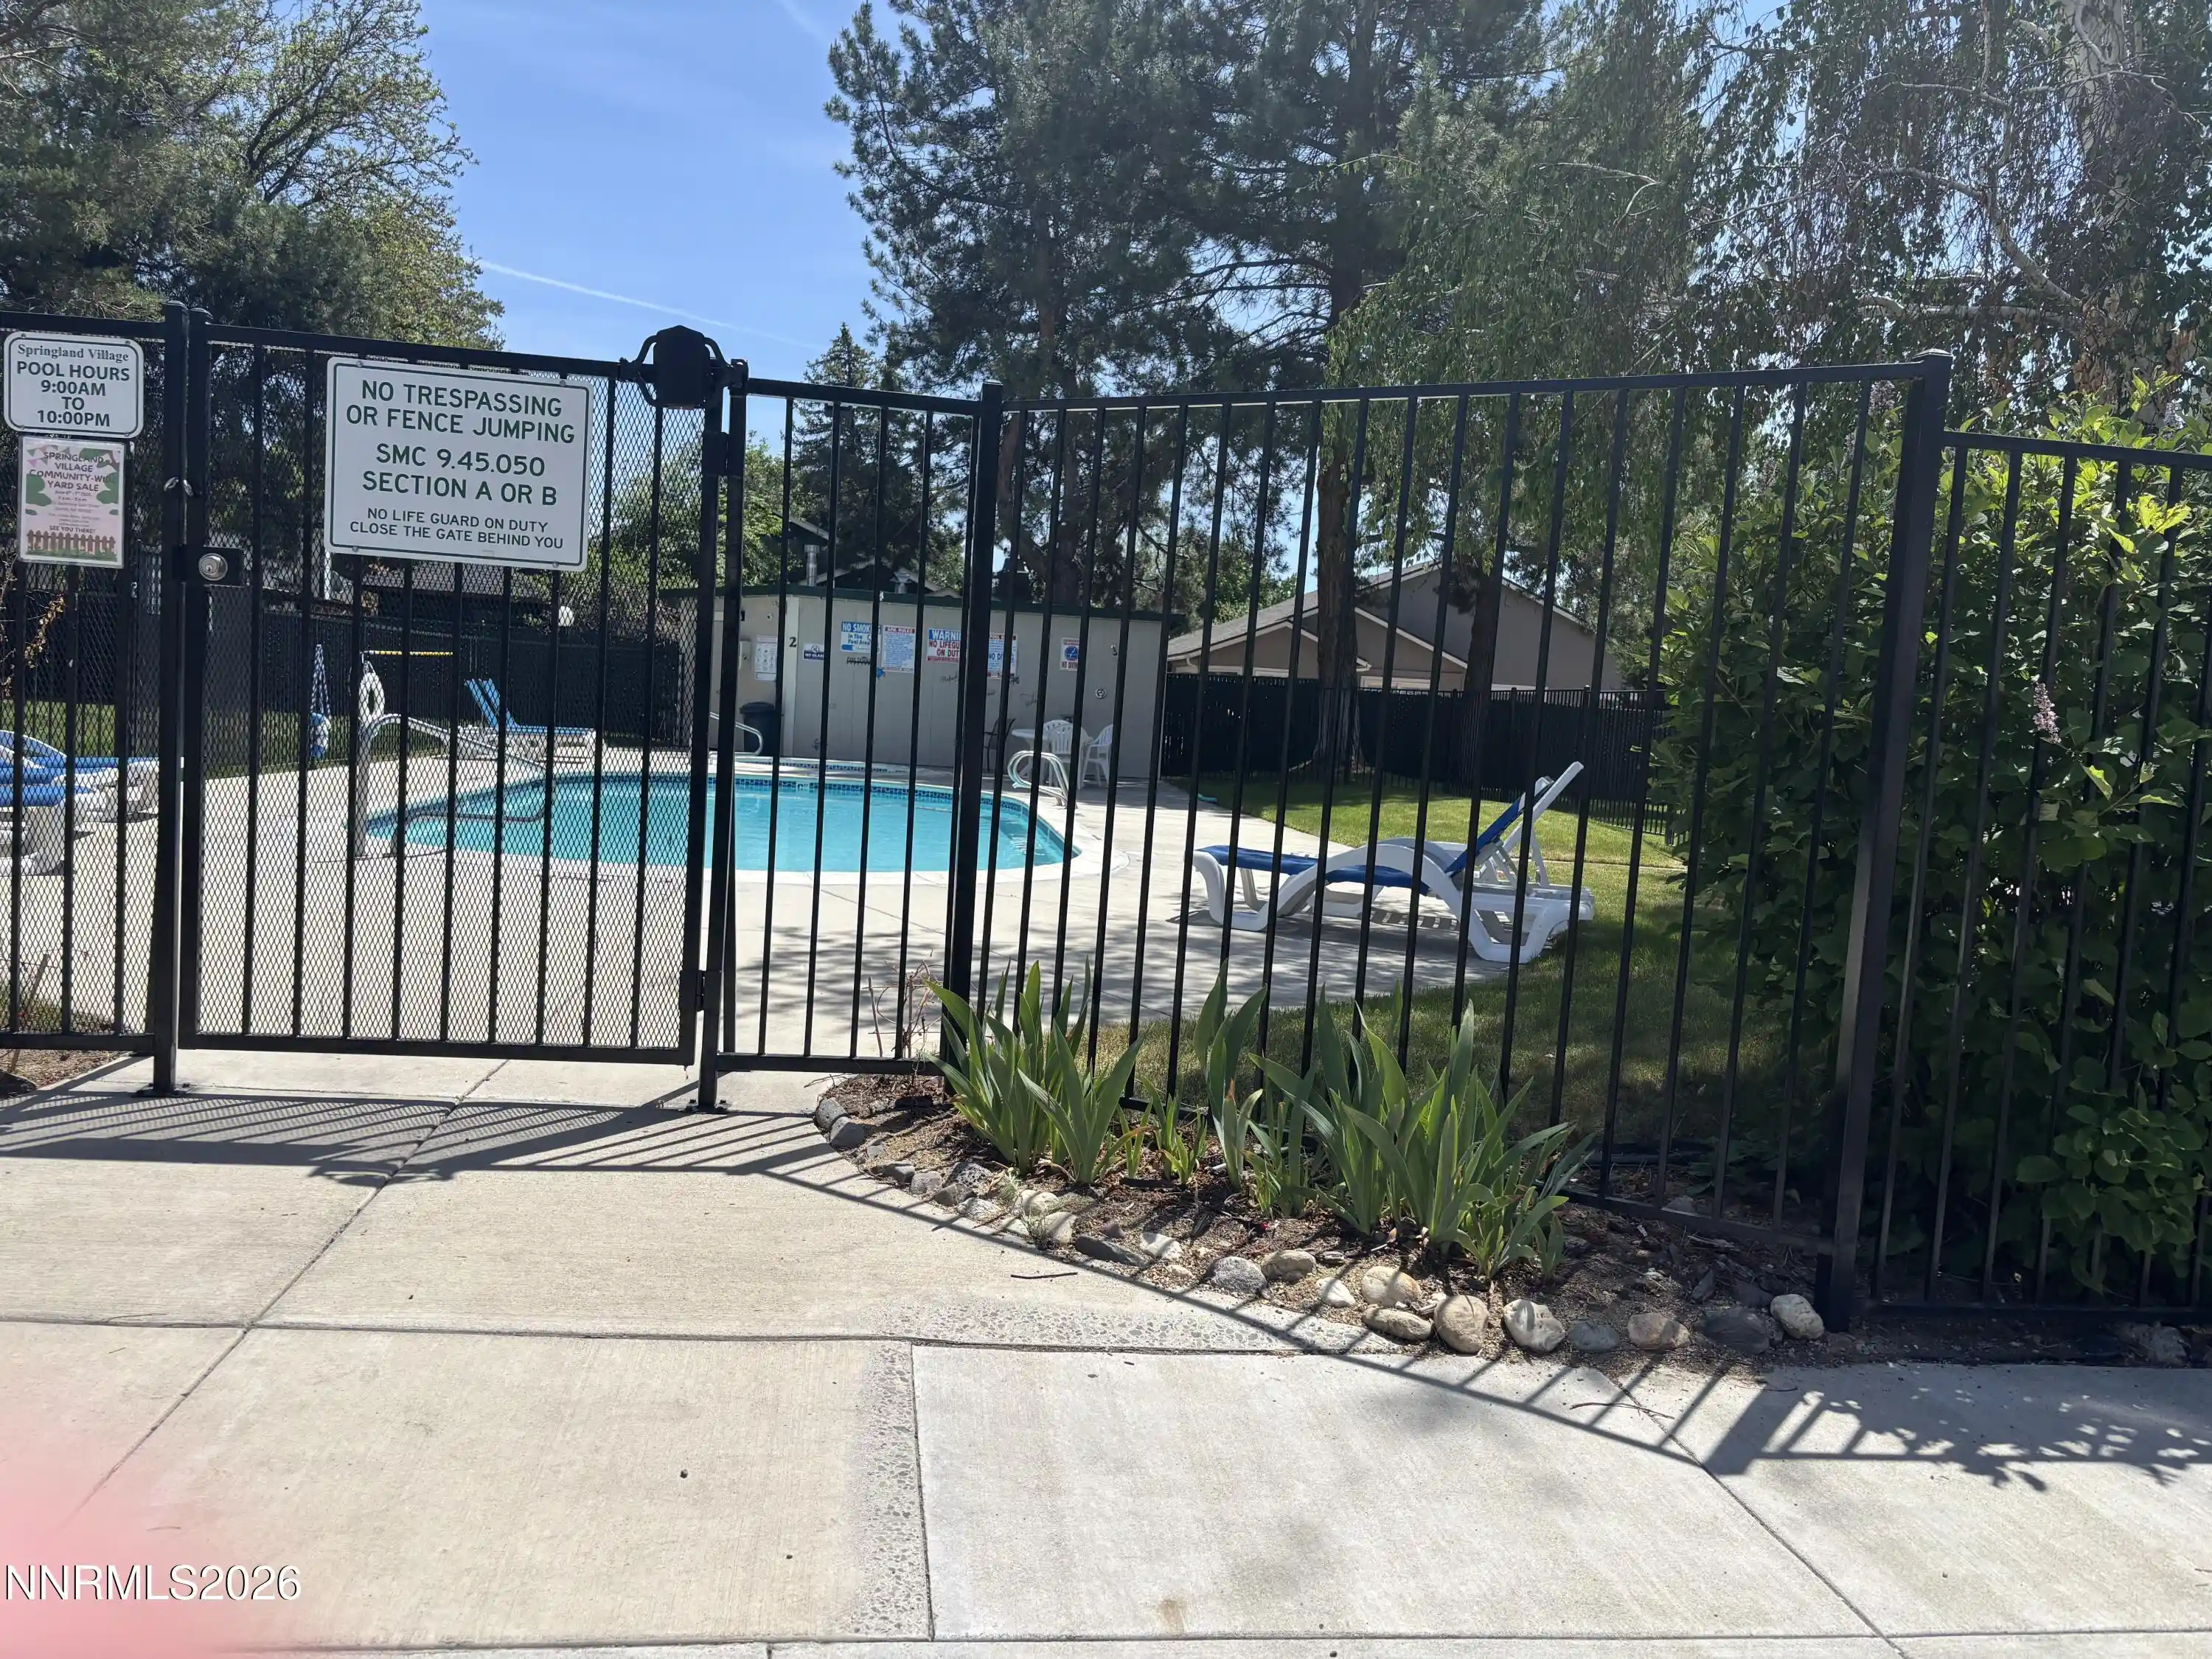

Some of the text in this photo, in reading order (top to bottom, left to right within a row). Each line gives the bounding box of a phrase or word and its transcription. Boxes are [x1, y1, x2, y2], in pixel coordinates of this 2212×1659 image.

[18, 344, 129, 363] Springland Village
[17, 361, 130, 381] POOL HOURS
[41, 380, 106, 396] 9:00AM
[61, 397, 85, 410] TO
[362, 380, 562, 417] NO TRESPASSING
[37, 410, 110, 427] 10:00PM
[347, 404, 575, 444] OR FENCE JUMPING
[44, 451, 104, 464] SPRINGLAND
[376, 443, 545, 476] SMC 9.45.050
[55, 462, 94, 472] VILLAGE
[47, 480, 100, 492] YARD SALE
[362, 470, 557, 506] SECTION A OR B
[367, 507, 549, 533] NO LIFE GUARD ON DUTY
[350, 521, 563, 549] CLOSE THE GATE BEHIND YOU
[842, 622, 852, 632] NO
[789, 636, 797, 647] 2
[932, 630, 961, 641] WARNI
[929, 640, 960, 650] NO LIFEGU
